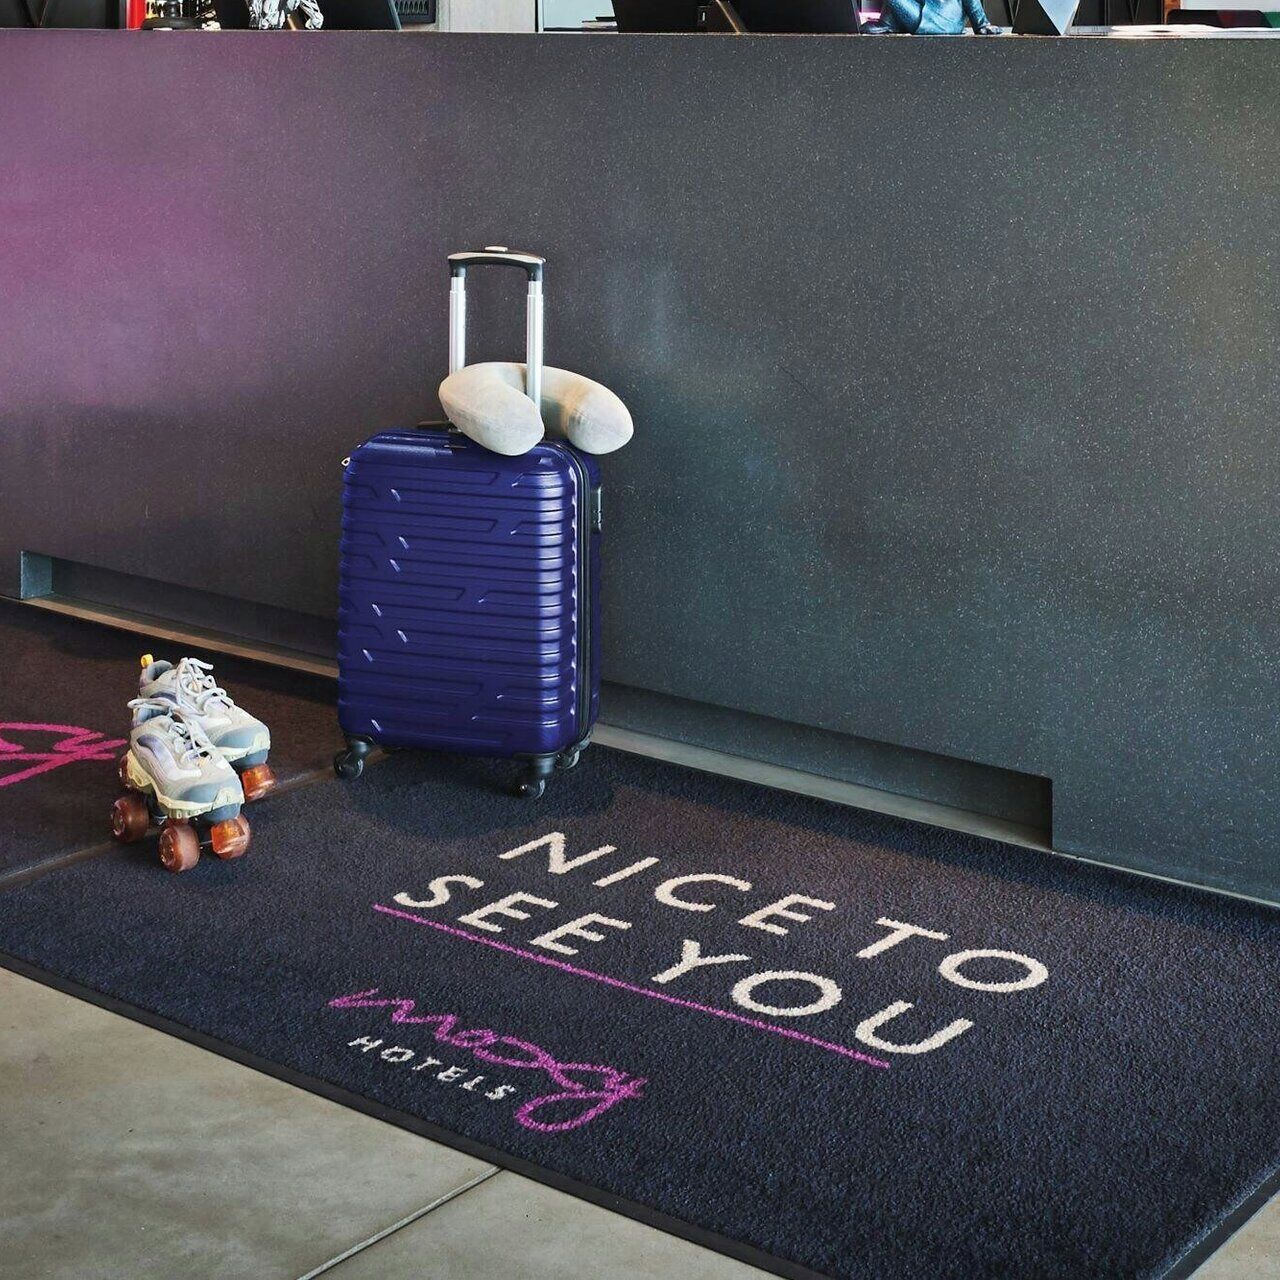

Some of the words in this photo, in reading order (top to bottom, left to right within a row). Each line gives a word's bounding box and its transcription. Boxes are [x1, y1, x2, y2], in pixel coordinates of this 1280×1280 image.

[393, 874, 632, 956] SEE
[651, 939, 975, 1055] YOU
[498, 831, 836, 936] NICE
[856, 916, 1050, 993] TO
[347, 1035, 517, 1100] HOTELS
